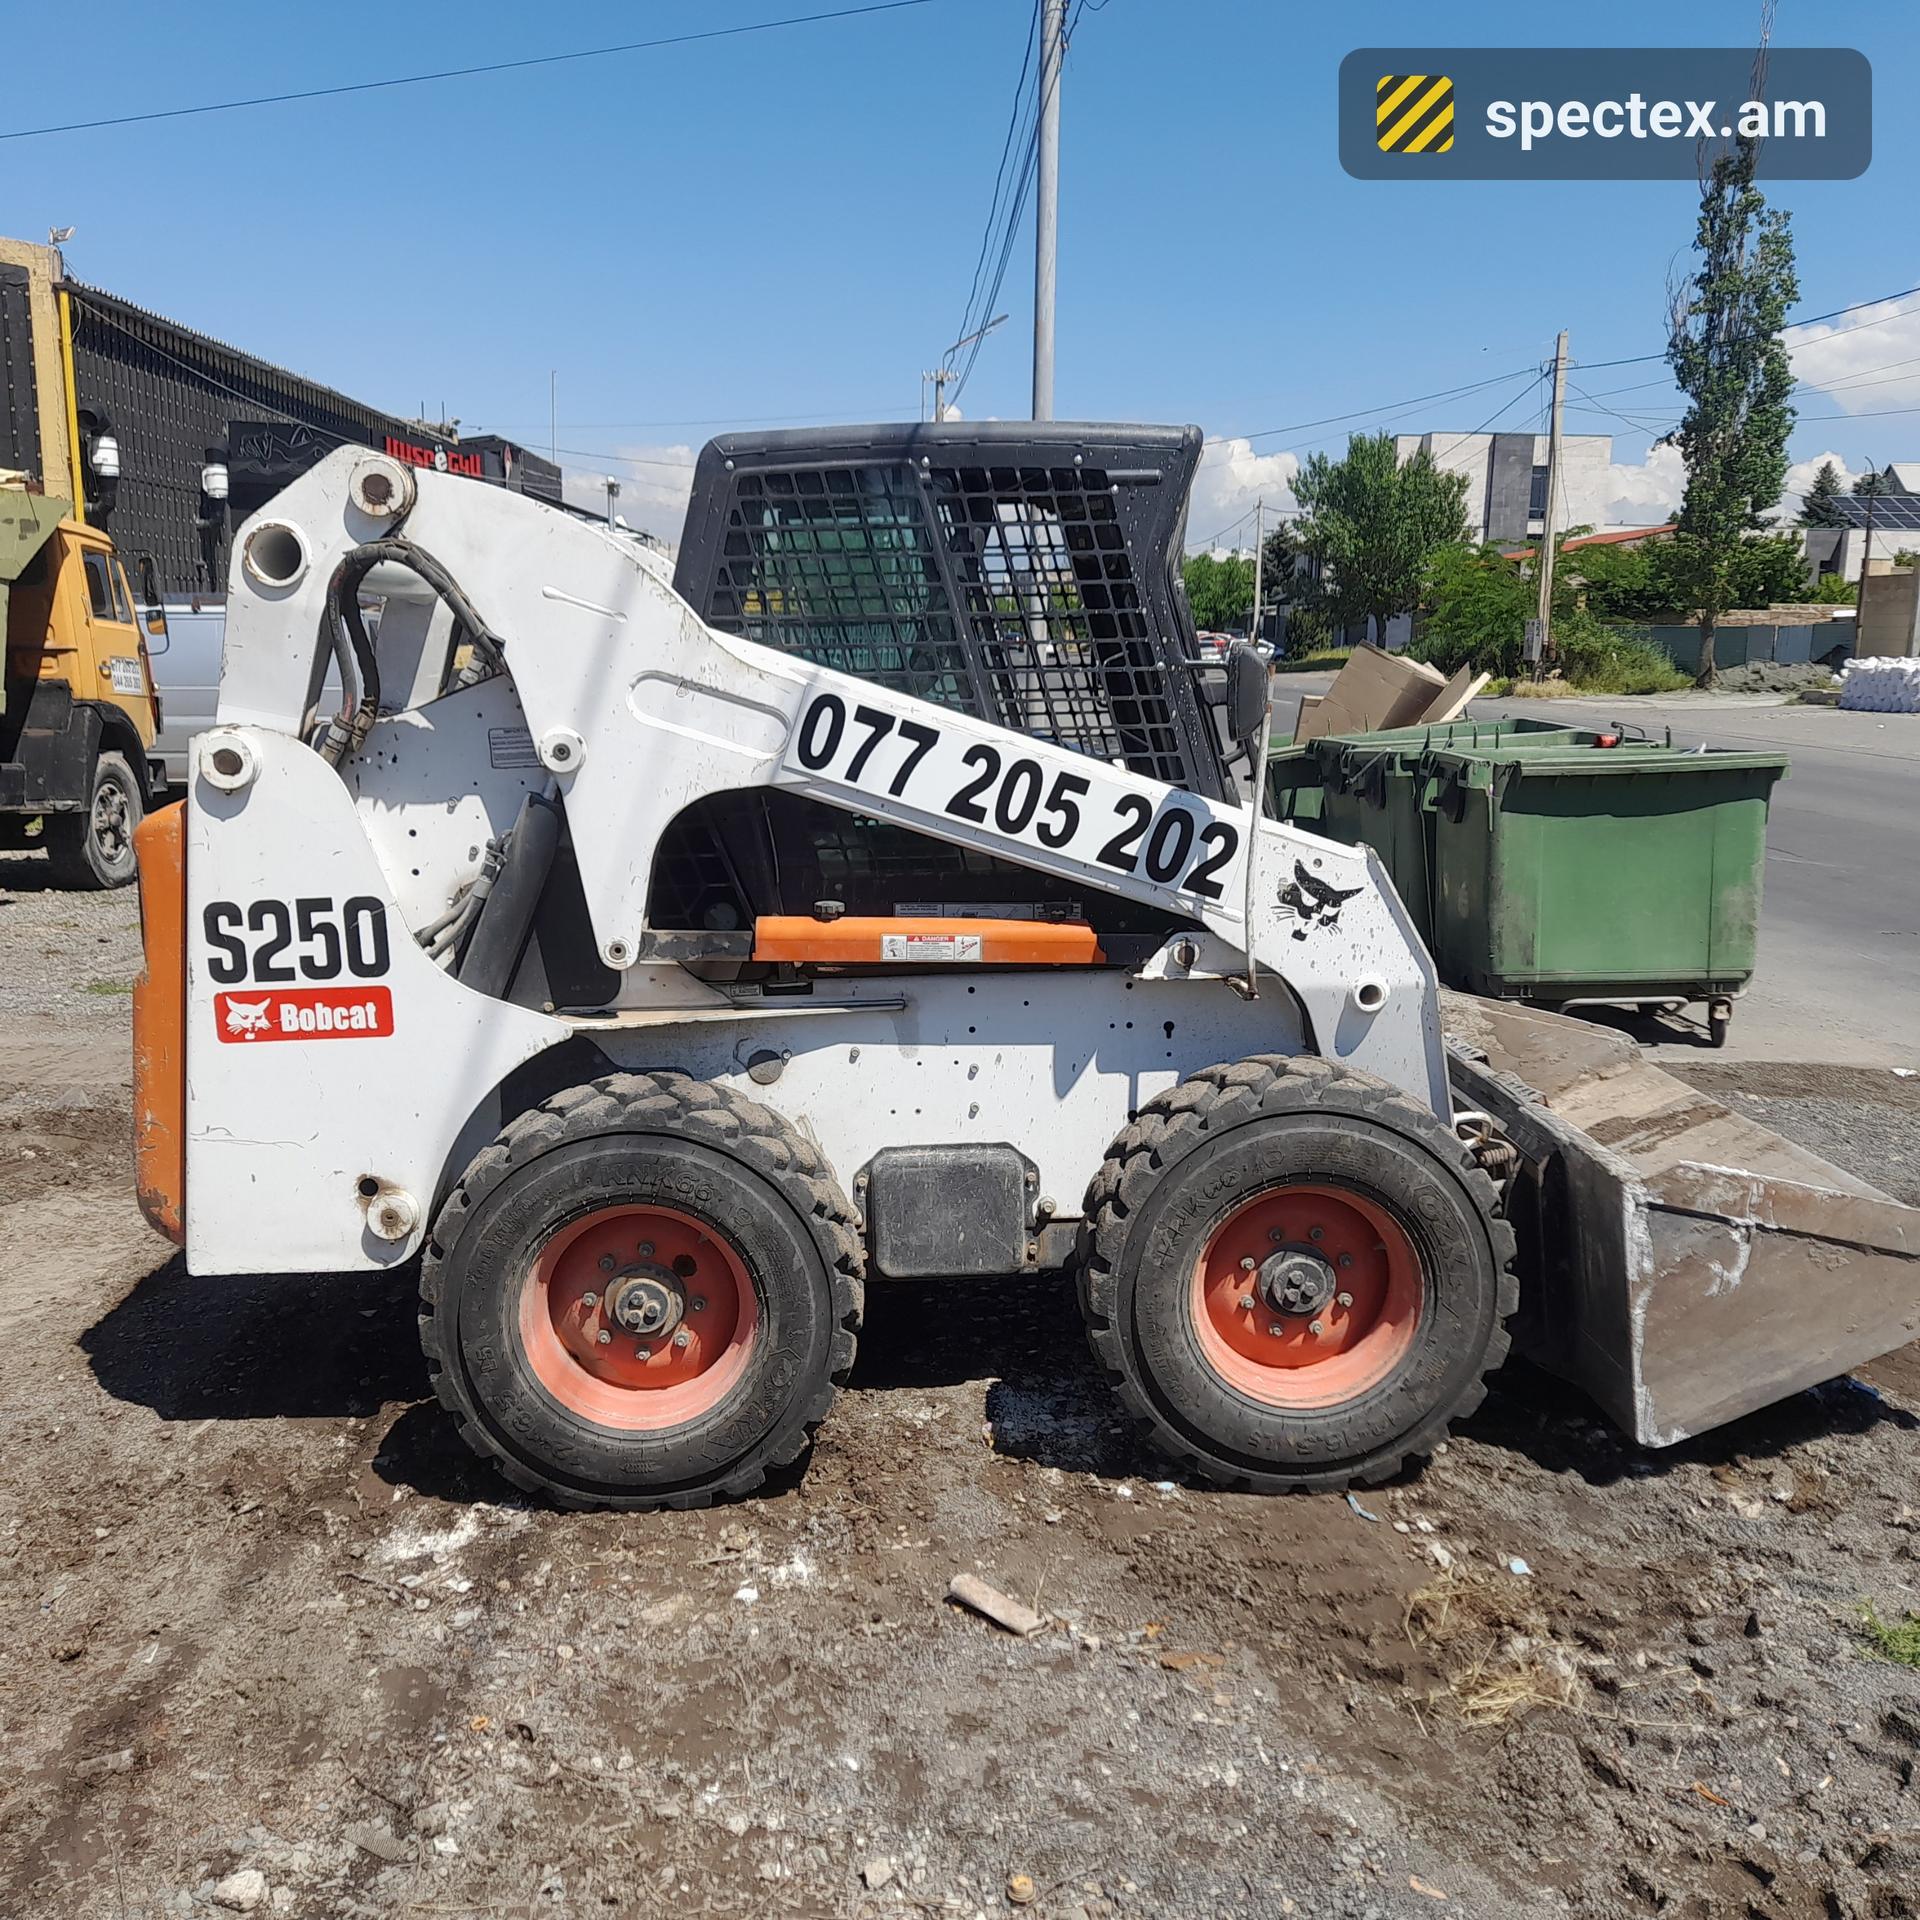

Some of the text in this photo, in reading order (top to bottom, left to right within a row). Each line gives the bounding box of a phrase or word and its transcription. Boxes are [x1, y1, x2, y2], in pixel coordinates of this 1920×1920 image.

[798, 694, 1239, 899] 077 205 202
[204, 896, 390, 984] S250
[280, 1002, 377, 1032] Bobcat
